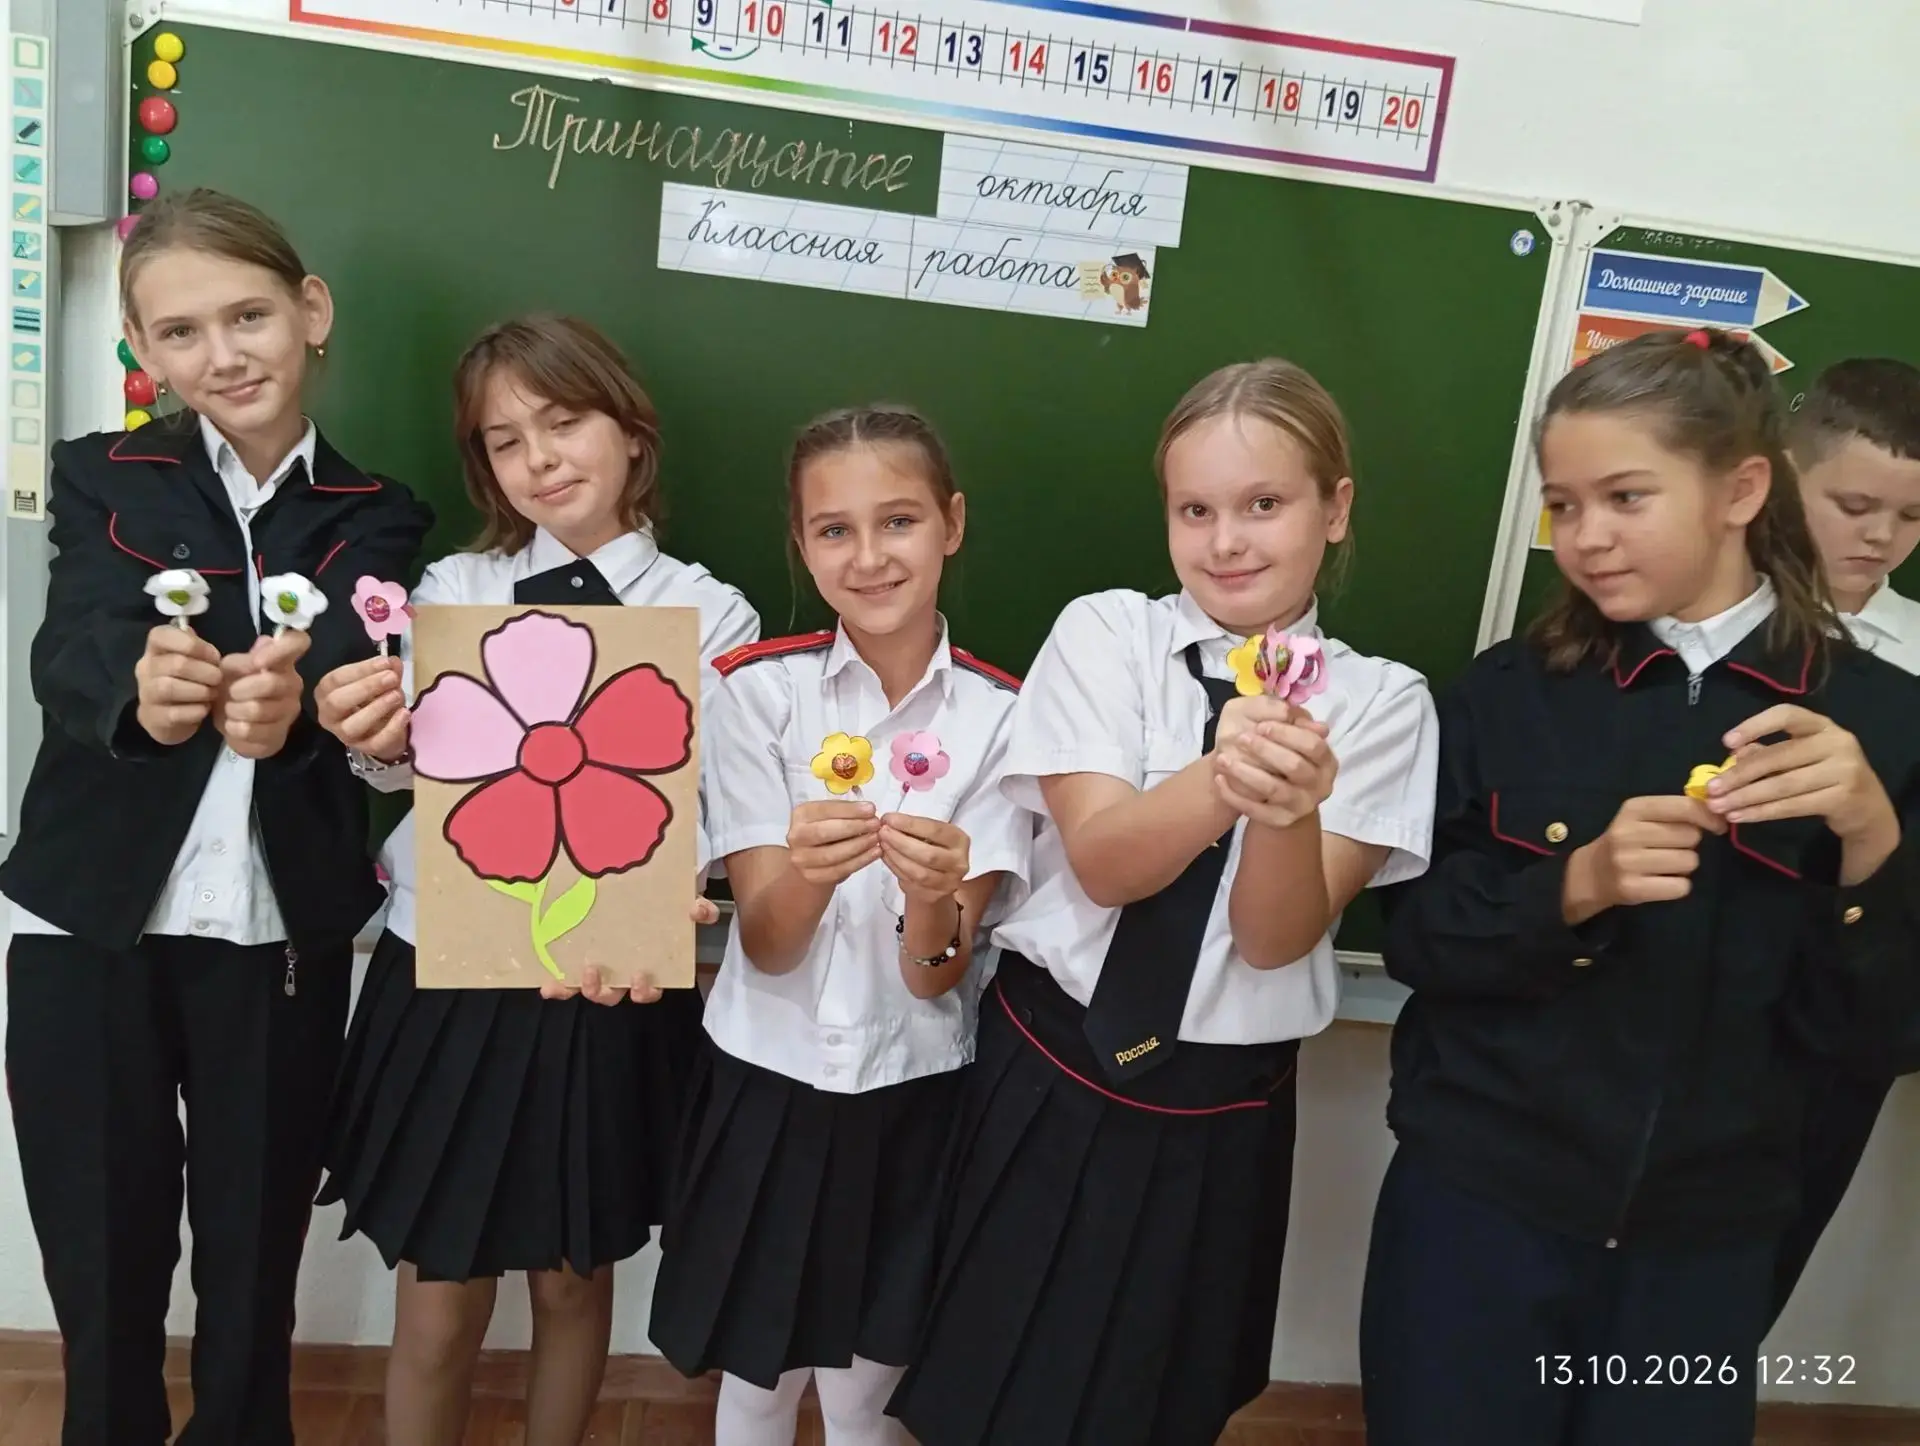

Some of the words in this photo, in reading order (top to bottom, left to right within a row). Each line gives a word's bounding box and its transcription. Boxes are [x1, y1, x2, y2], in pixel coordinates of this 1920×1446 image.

[697, 0, 713, 25] 9
[744, 2, 783, 36] 10
[812, 12, 849, 46] 11
[878, 21, 917, 56] 12
[944, 31, 982, 65] 13
[1009, 40, 1045, 75] 14
[1074, 50, 1109, 84] 15
[1137, 60, 1172, 93] 16
[1201, 69, 1238, 102] 17
[1264, 78, 1299, 112] 18
[1324, 87, 1360, 120] 19
[1383, 96, 1420, 129] 20
[493, 84, 913, 192] Тринадцатое
[688, 199, 884, 264] Классная
[914, 238, 1081, 289] работа
[976, 169, 1147, 230] октября
[1598, 268, 1681, 296] Домашнее
[1680, 284, 1748, 308] задание
